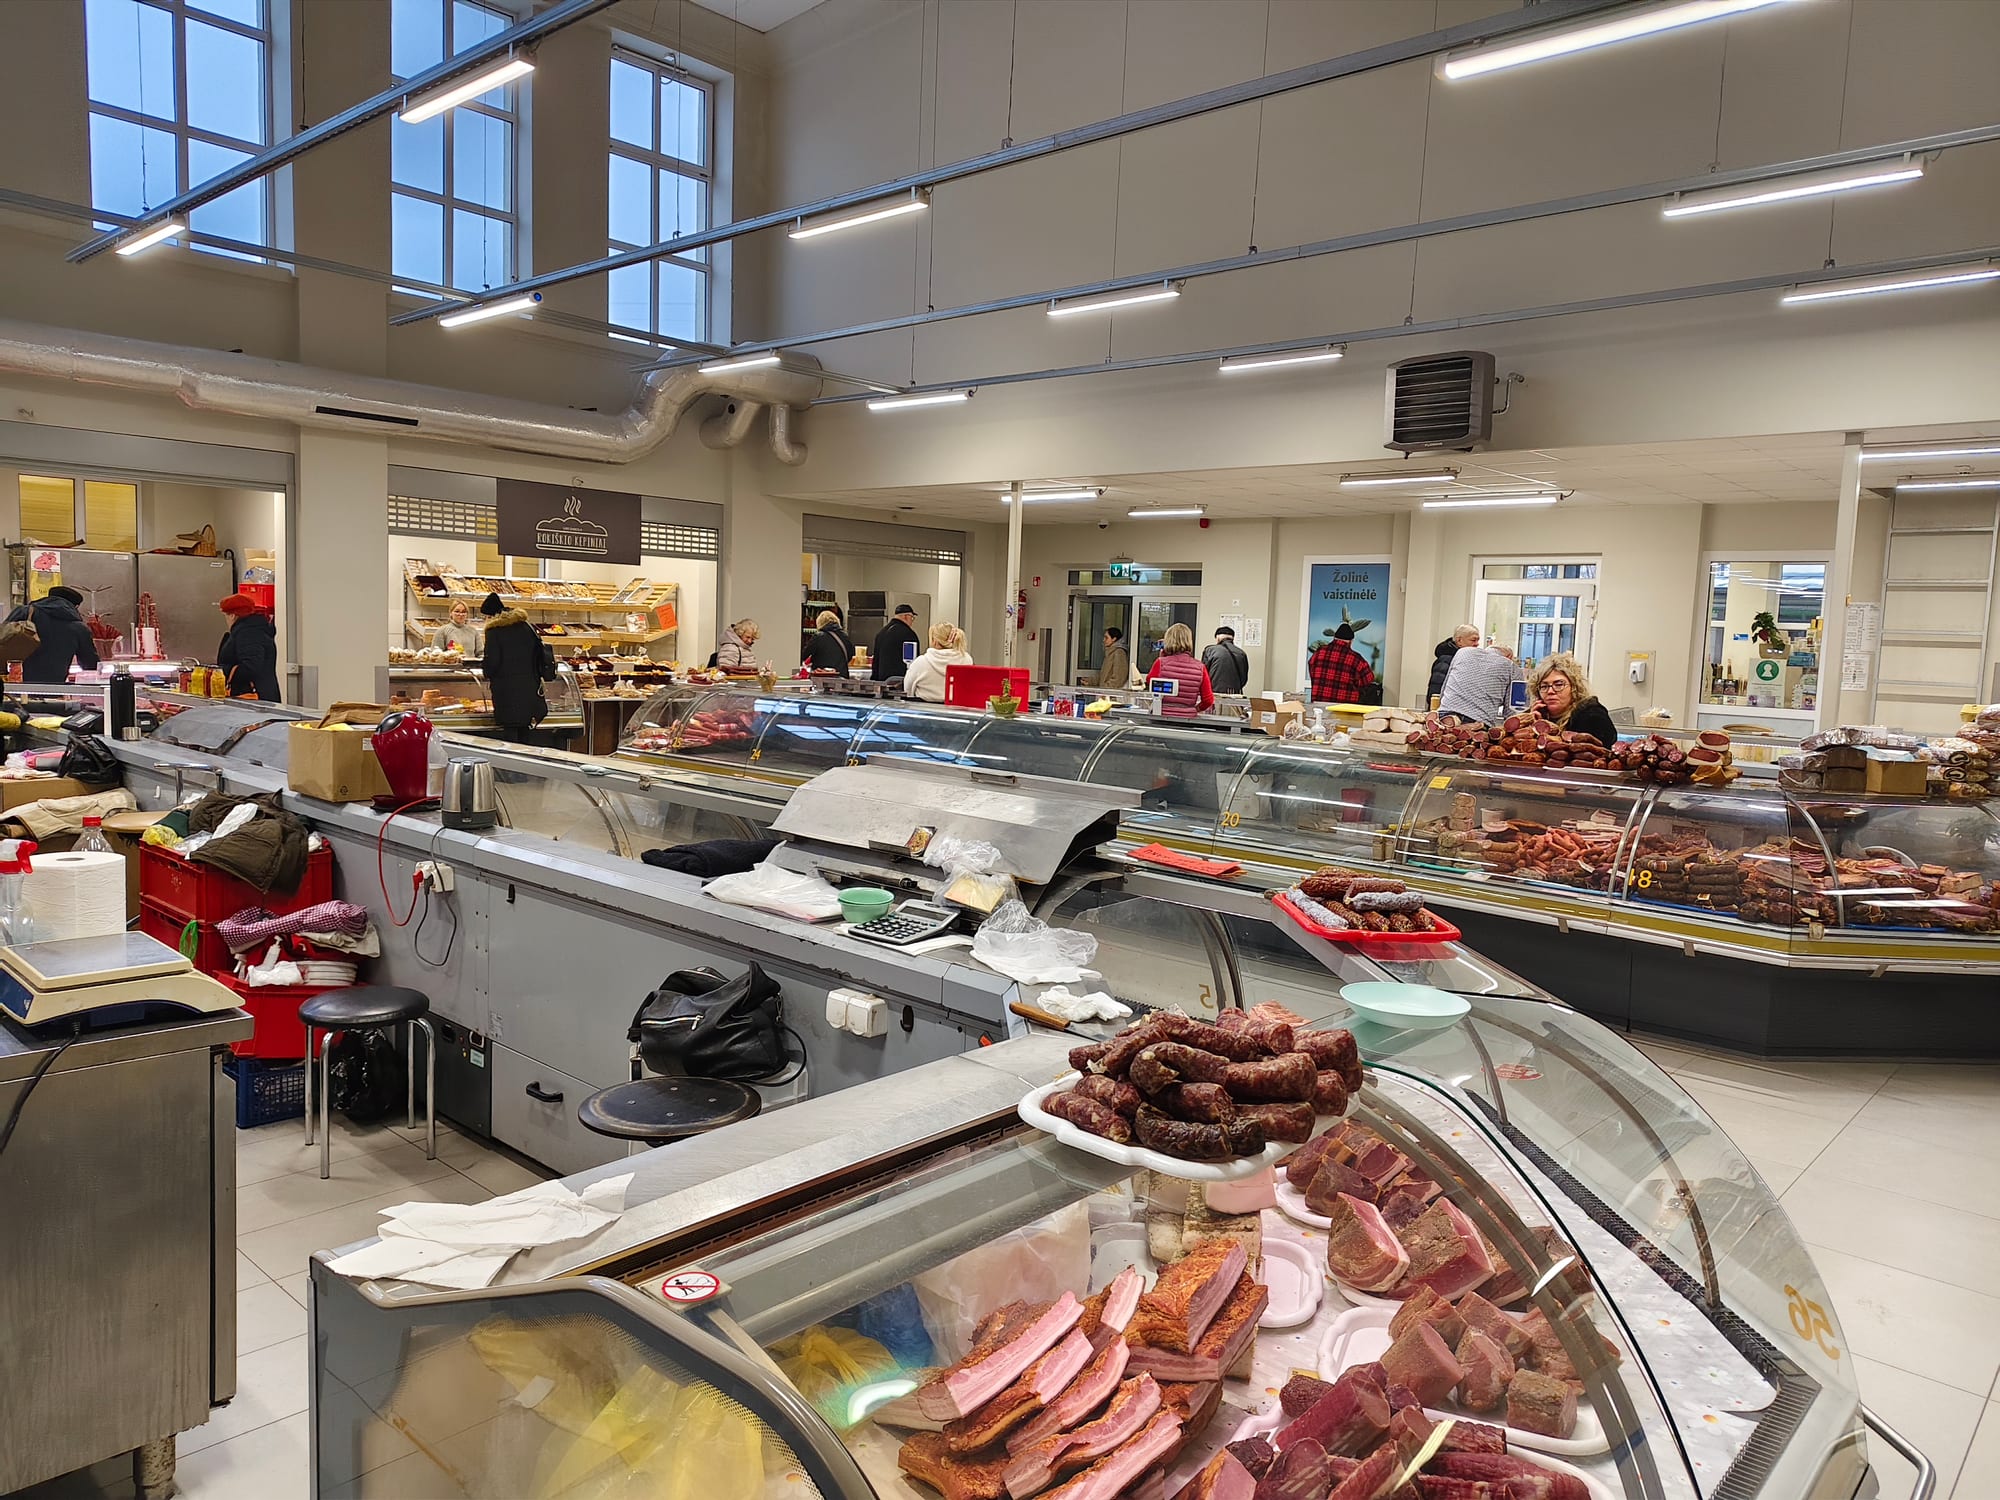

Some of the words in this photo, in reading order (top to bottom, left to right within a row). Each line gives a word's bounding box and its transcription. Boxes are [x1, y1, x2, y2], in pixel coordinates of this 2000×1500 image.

[537, 532, 572, 546] ROKIŠKIO
[574, 535, 607, 549] KEPINIAI
[1332, 568, 1369, 583] Žolinė
[1323, 588, 1377, 600] vaistinėlė
[750, 748, 762, 760] 24
[1220, 811, 1240, 828] 20
